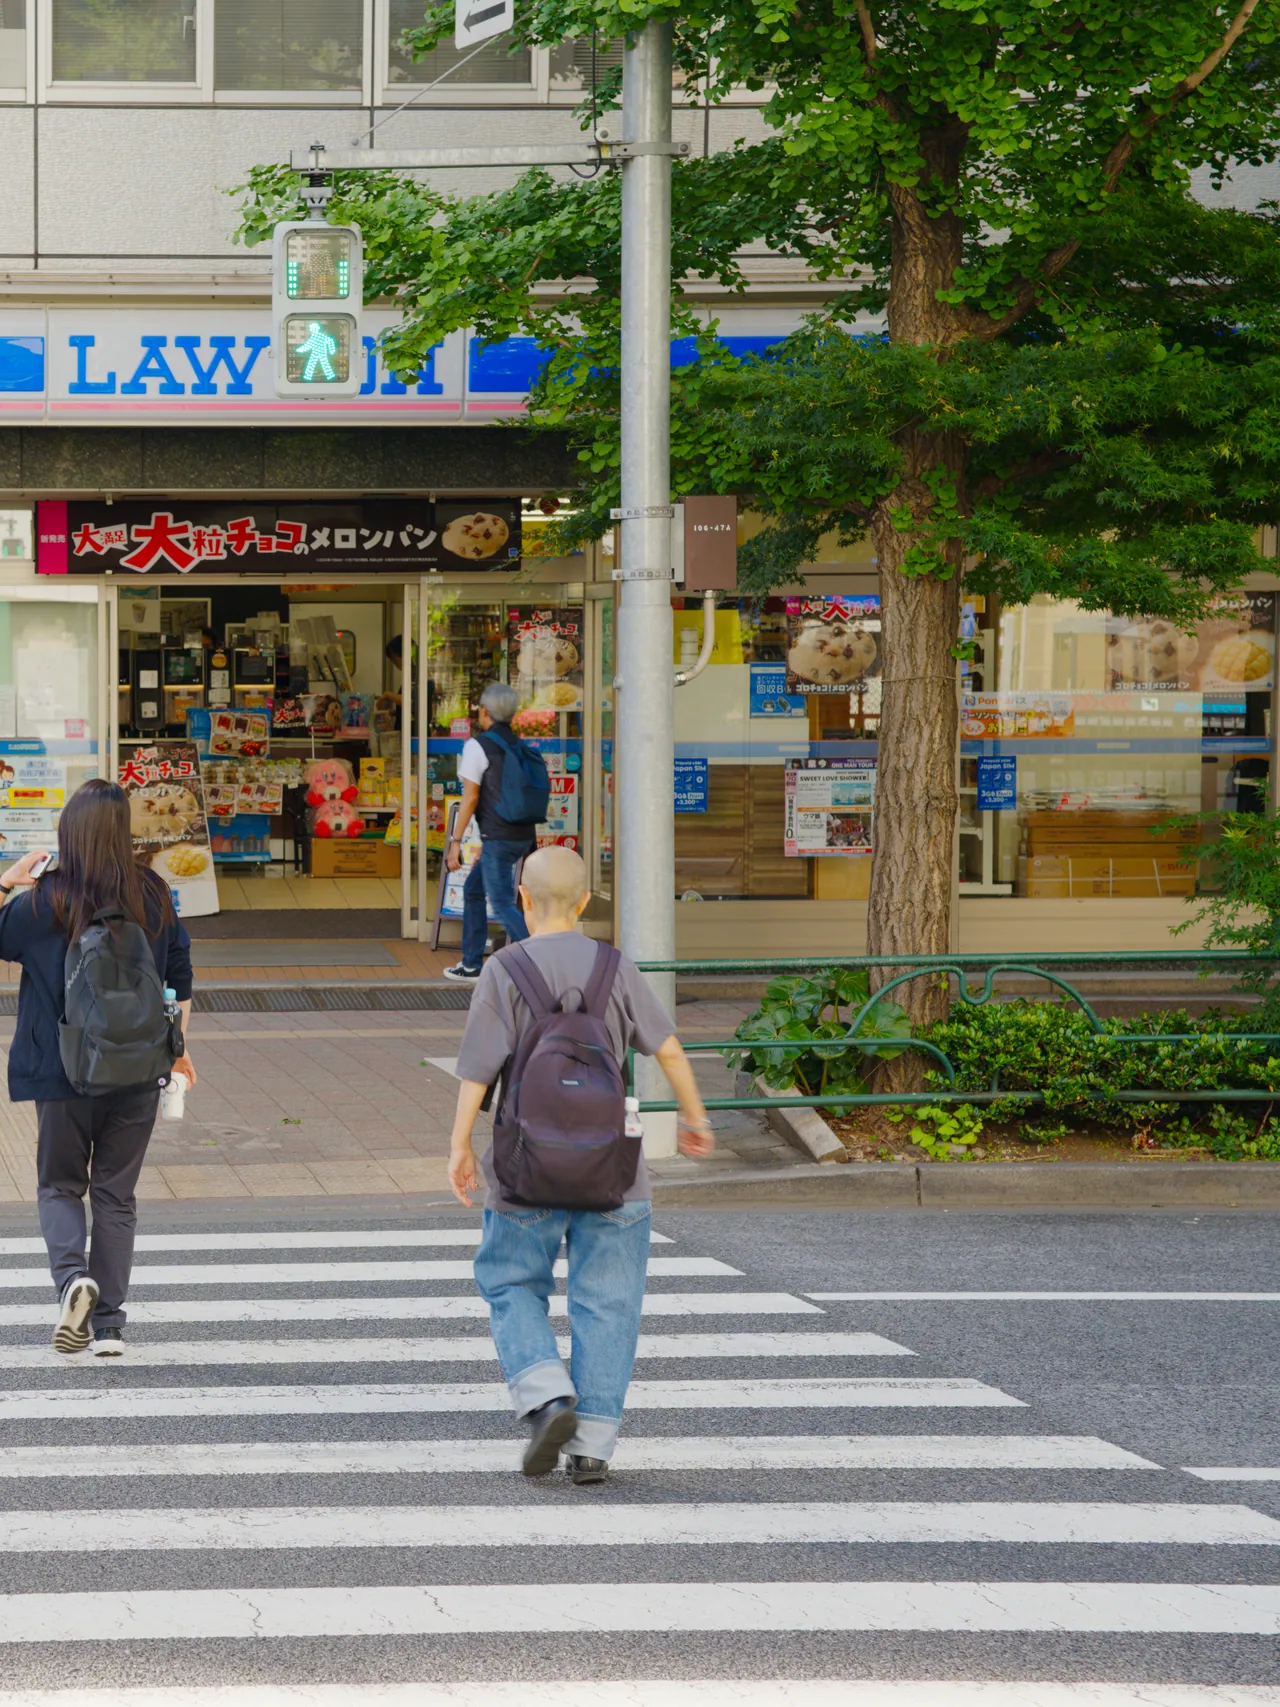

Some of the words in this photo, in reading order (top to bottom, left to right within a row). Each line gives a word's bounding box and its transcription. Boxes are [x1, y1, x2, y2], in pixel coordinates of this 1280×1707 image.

[68, 335, 444, 395] LAWN
[40, 534, 67, 544] 新発売
[756, 685, 788, 695] 回収B
